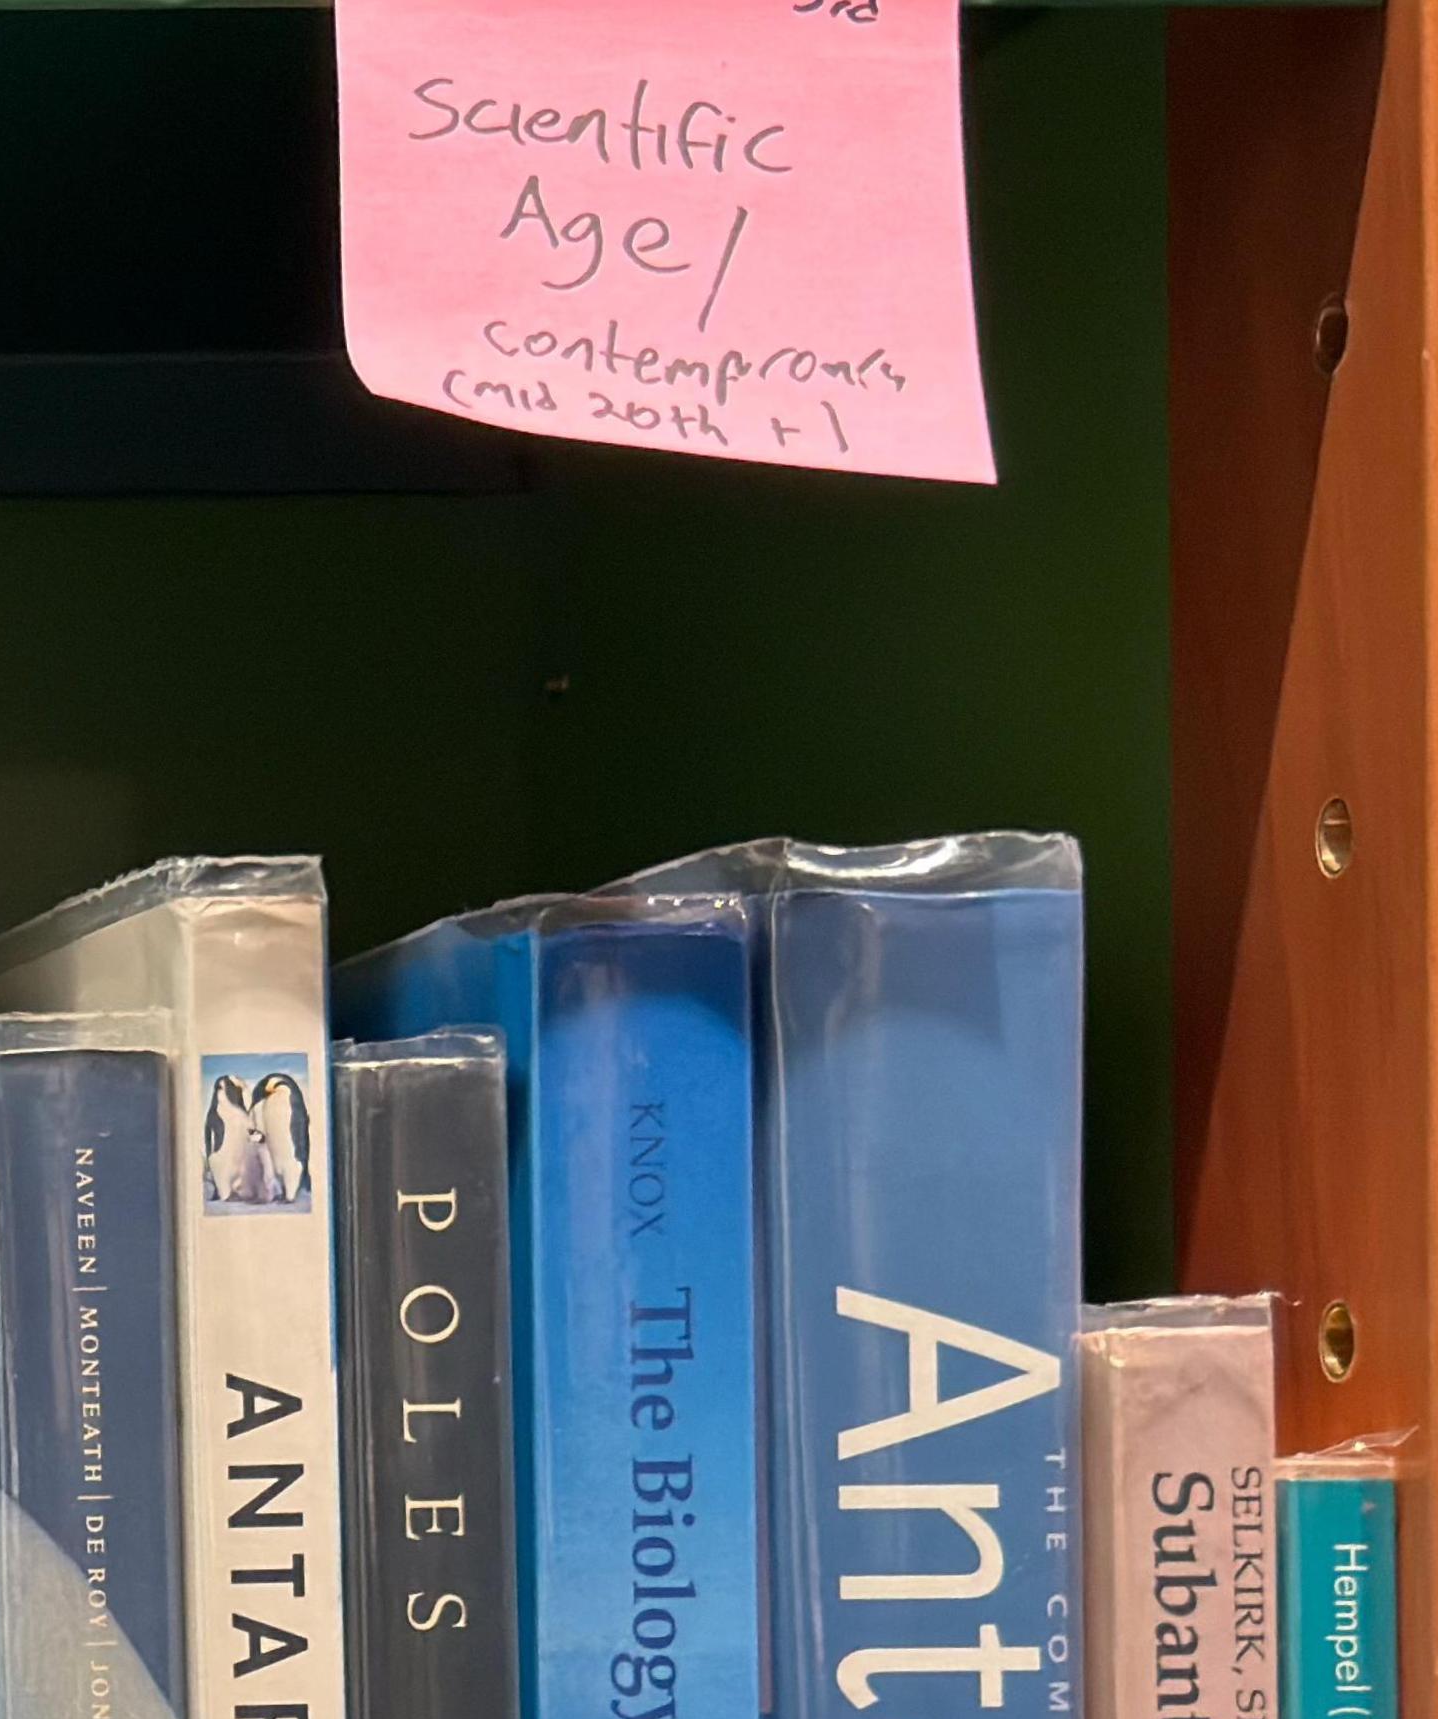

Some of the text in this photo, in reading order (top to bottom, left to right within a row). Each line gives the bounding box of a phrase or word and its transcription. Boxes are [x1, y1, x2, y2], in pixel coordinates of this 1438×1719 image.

[408, 78, 792, 172] Scientific
[589, 392, 729, 446] 20th
[74, 1148, 96, 1274] NAVEEN
[628, 1099, 666, 1238] KNOX
[80, 1306, 103, 1483] MONTEATH
[393, 1186, 470, 1634] POLES
[627, 1285, 694, 1435] The
[86, 1515, 105, 1553] DE
[1044, 1447, 1068, 1552] THE
[87, 1567, 108, 1627] ROY
[1231, 1465, 1265, 1678] SELKIRK,
[1328, 1540, 1371, 1694] Hempel
